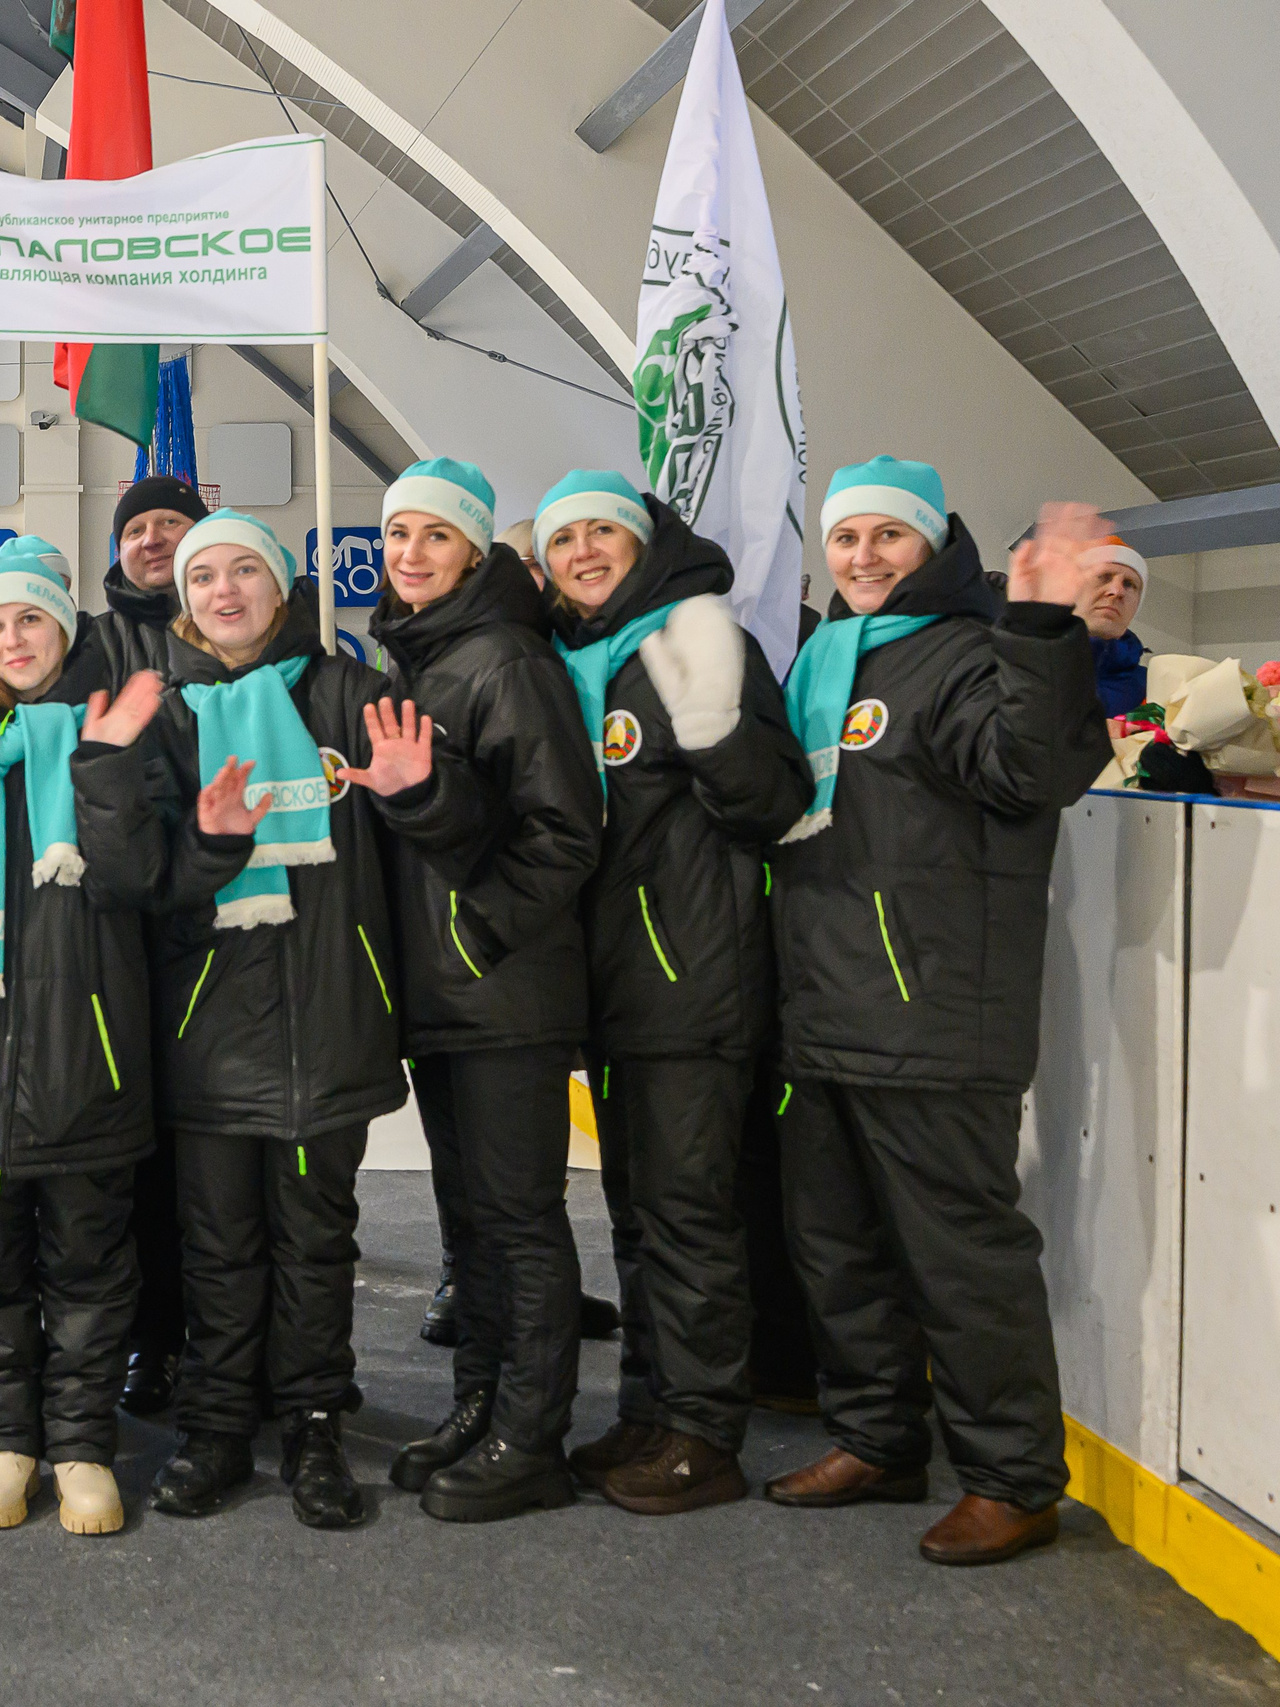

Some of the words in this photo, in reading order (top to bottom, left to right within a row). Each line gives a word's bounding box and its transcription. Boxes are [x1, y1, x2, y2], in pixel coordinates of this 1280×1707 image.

[78, 215, 143, 228] унитарное
[147, 210, 229, 226] предприятие
[86, 271, 173, 286] компания
[179, 266, 268, 284] холдинга
